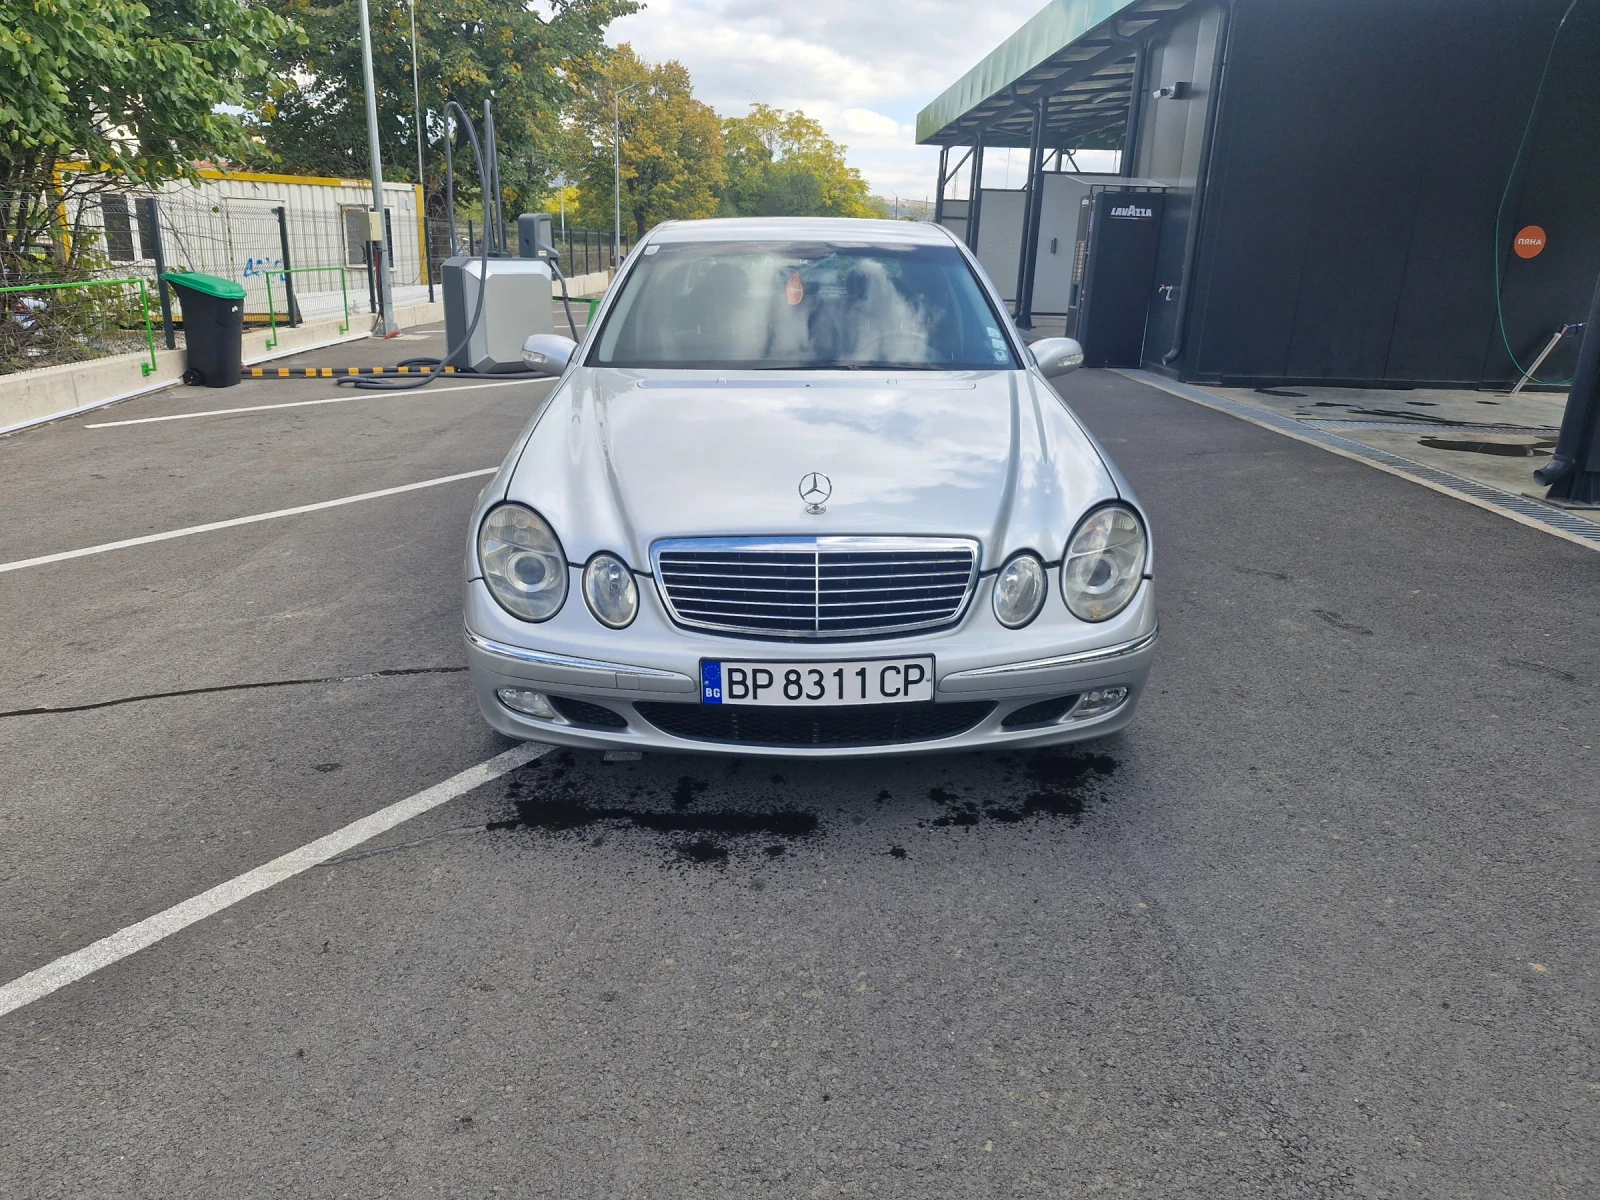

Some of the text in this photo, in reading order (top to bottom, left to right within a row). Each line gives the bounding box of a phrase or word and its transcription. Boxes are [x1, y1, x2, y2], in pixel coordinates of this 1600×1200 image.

[1110, 205, 1152, 217] LAVAZZA
[1517, 238, 1542, 246] ПЯНА
[727, 663, 925, 700] BP 8311 CP
[705, 687, 721, 698] BG
